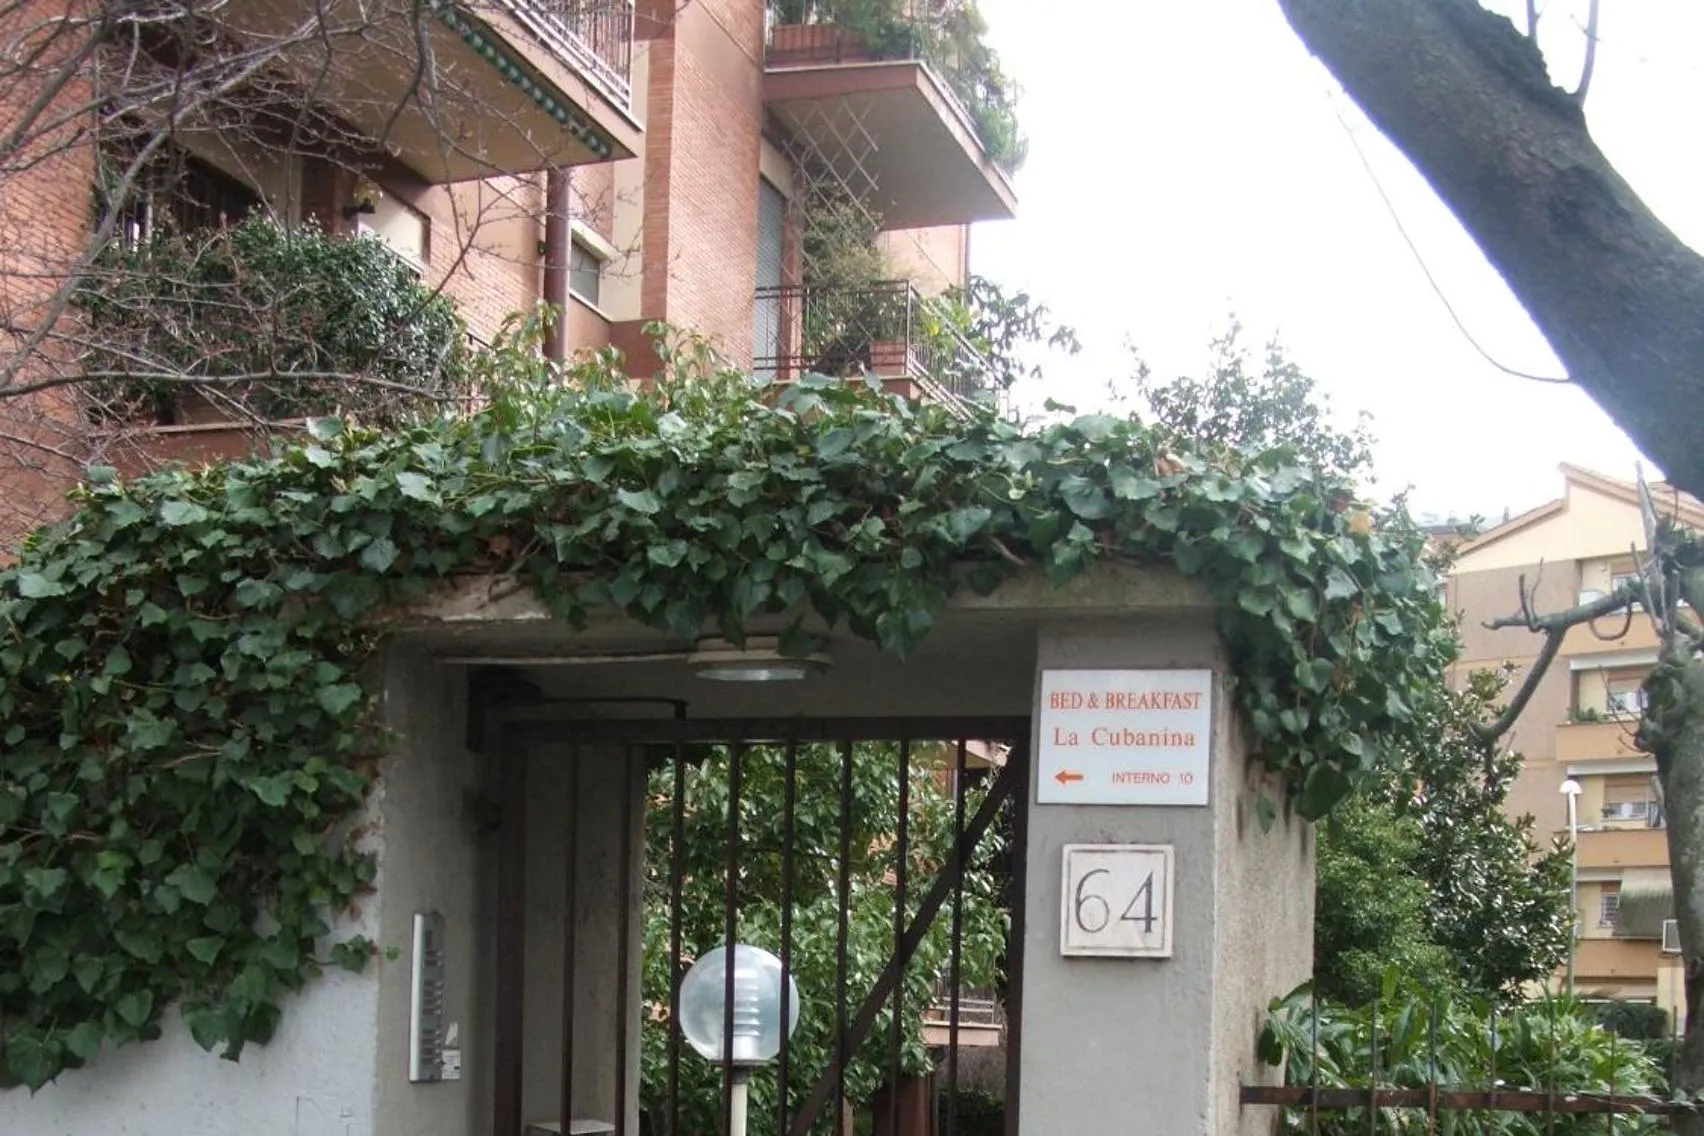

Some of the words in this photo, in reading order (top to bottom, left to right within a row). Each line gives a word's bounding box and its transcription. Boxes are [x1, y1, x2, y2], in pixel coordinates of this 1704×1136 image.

[1050, 692, 1083, 710] BED
[1087, 692, 1100, 710] &
[1105, 692, 1202, 710] BREAKFAST
[1053, 727, 1078, 746] La
[1091, 726, 1195, 746] Cubanina
[1111, 772, 1170, 784] INTERNO
[1179, 773, 1193, 784] 10
[1074, 868, 1159, 933] 64
